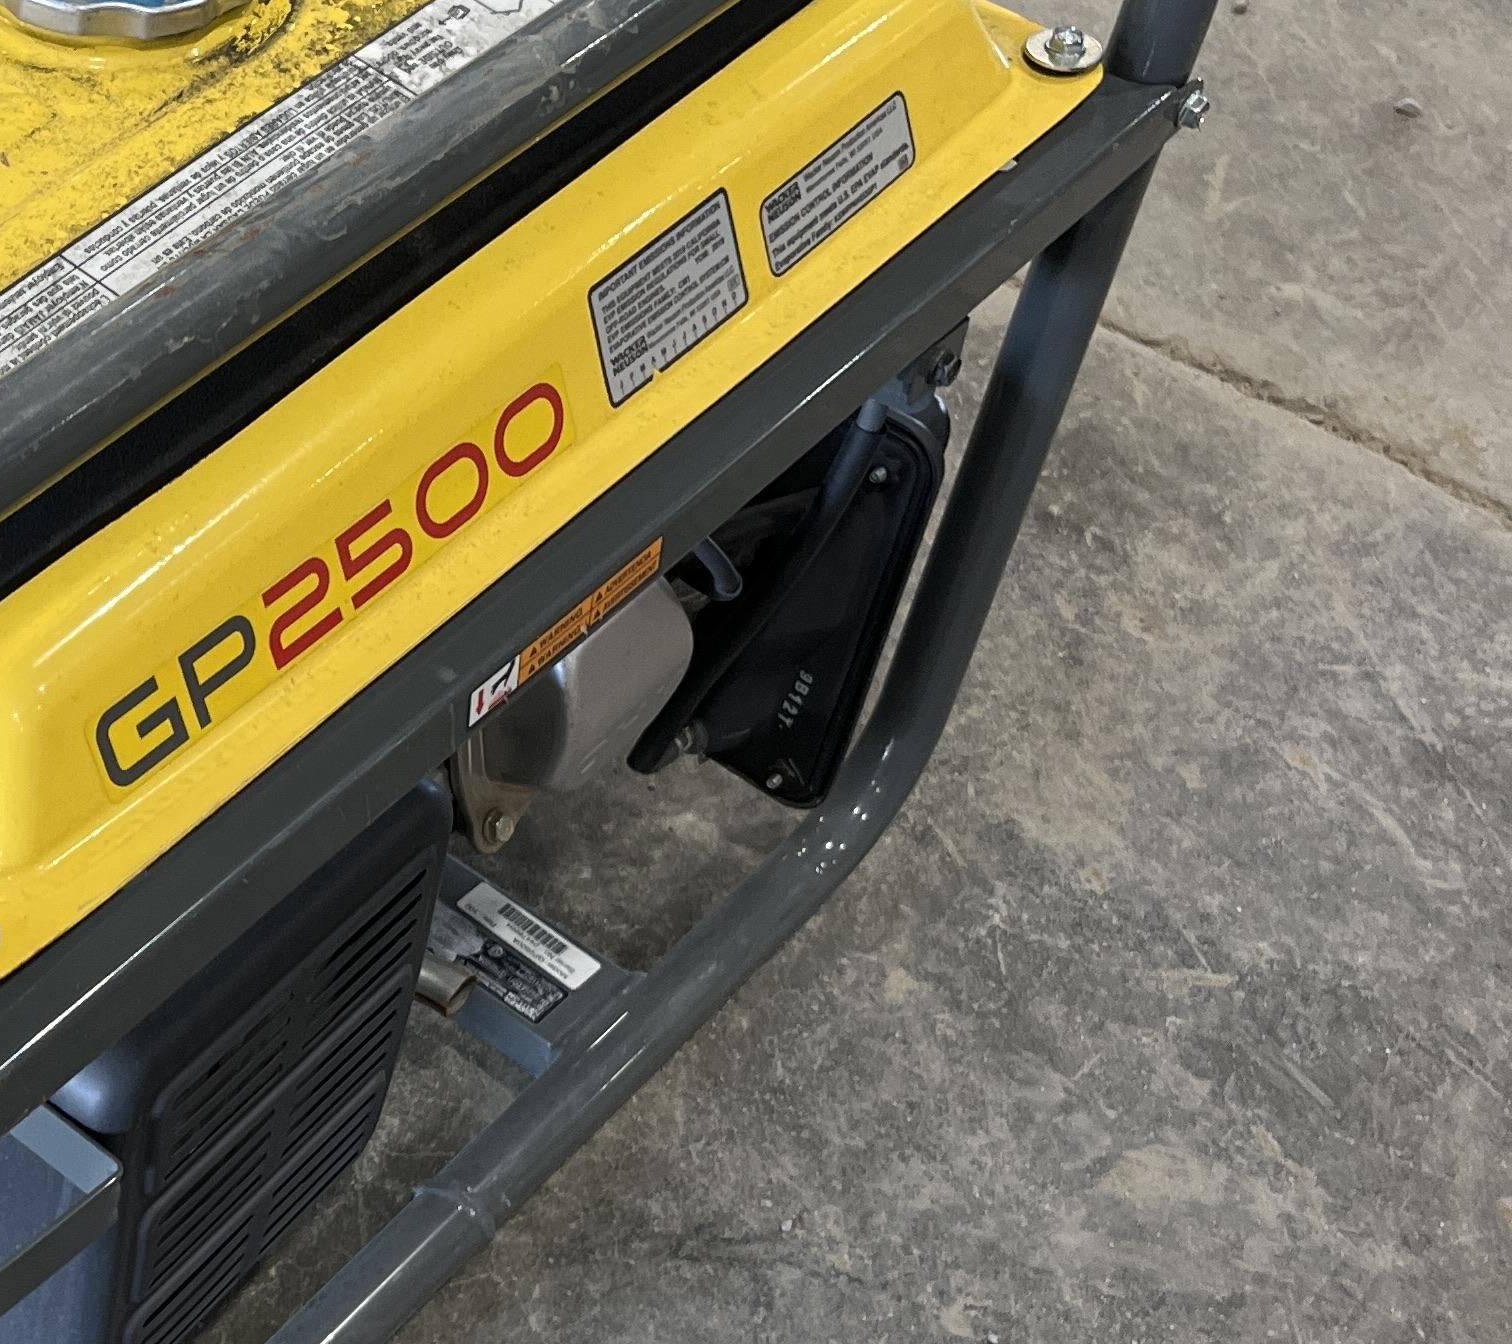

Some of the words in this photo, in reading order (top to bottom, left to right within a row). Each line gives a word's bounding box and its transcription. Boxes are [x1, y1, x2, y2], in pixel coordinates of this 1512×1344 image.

[764, 179, 799, 215] WACKER
[767, 188, 801, 225] NEUSON
[610, 332, 646, 369] WACKER
[612, 340, 648, 378] NEUSON
[95, 382, 564, 787] GP2500
